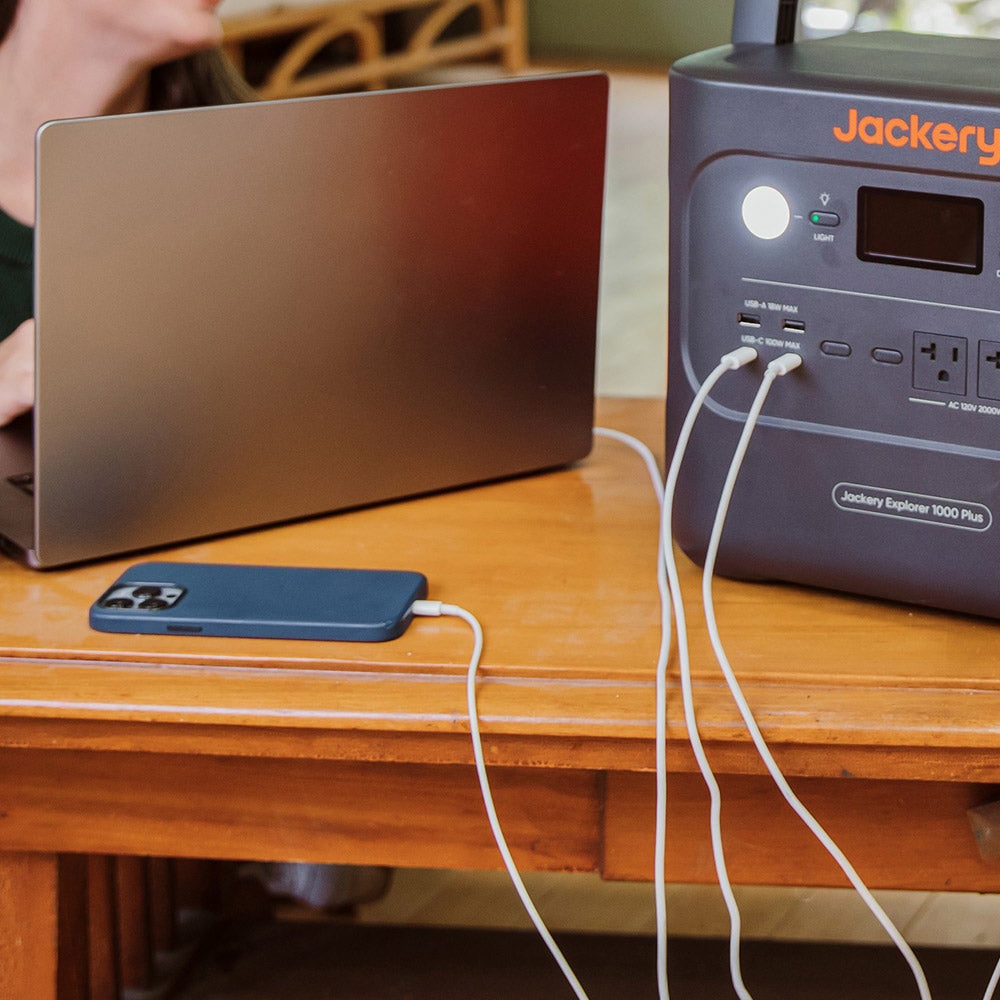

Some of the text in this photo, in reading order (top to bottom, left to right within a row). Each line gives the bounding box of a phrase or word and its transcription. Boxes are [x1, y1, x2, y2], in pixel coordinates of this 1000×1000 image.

[813, 233, 834, 242] LIGHT
[782, 304, 798, 313] MAX
[784, 340, 801, 349] MAX
[948, 400, 959, 410] AC
[960, 402, 977, 412] 120V
[841, 491, 984, 523] Jackery Explorer 1000 Plus
